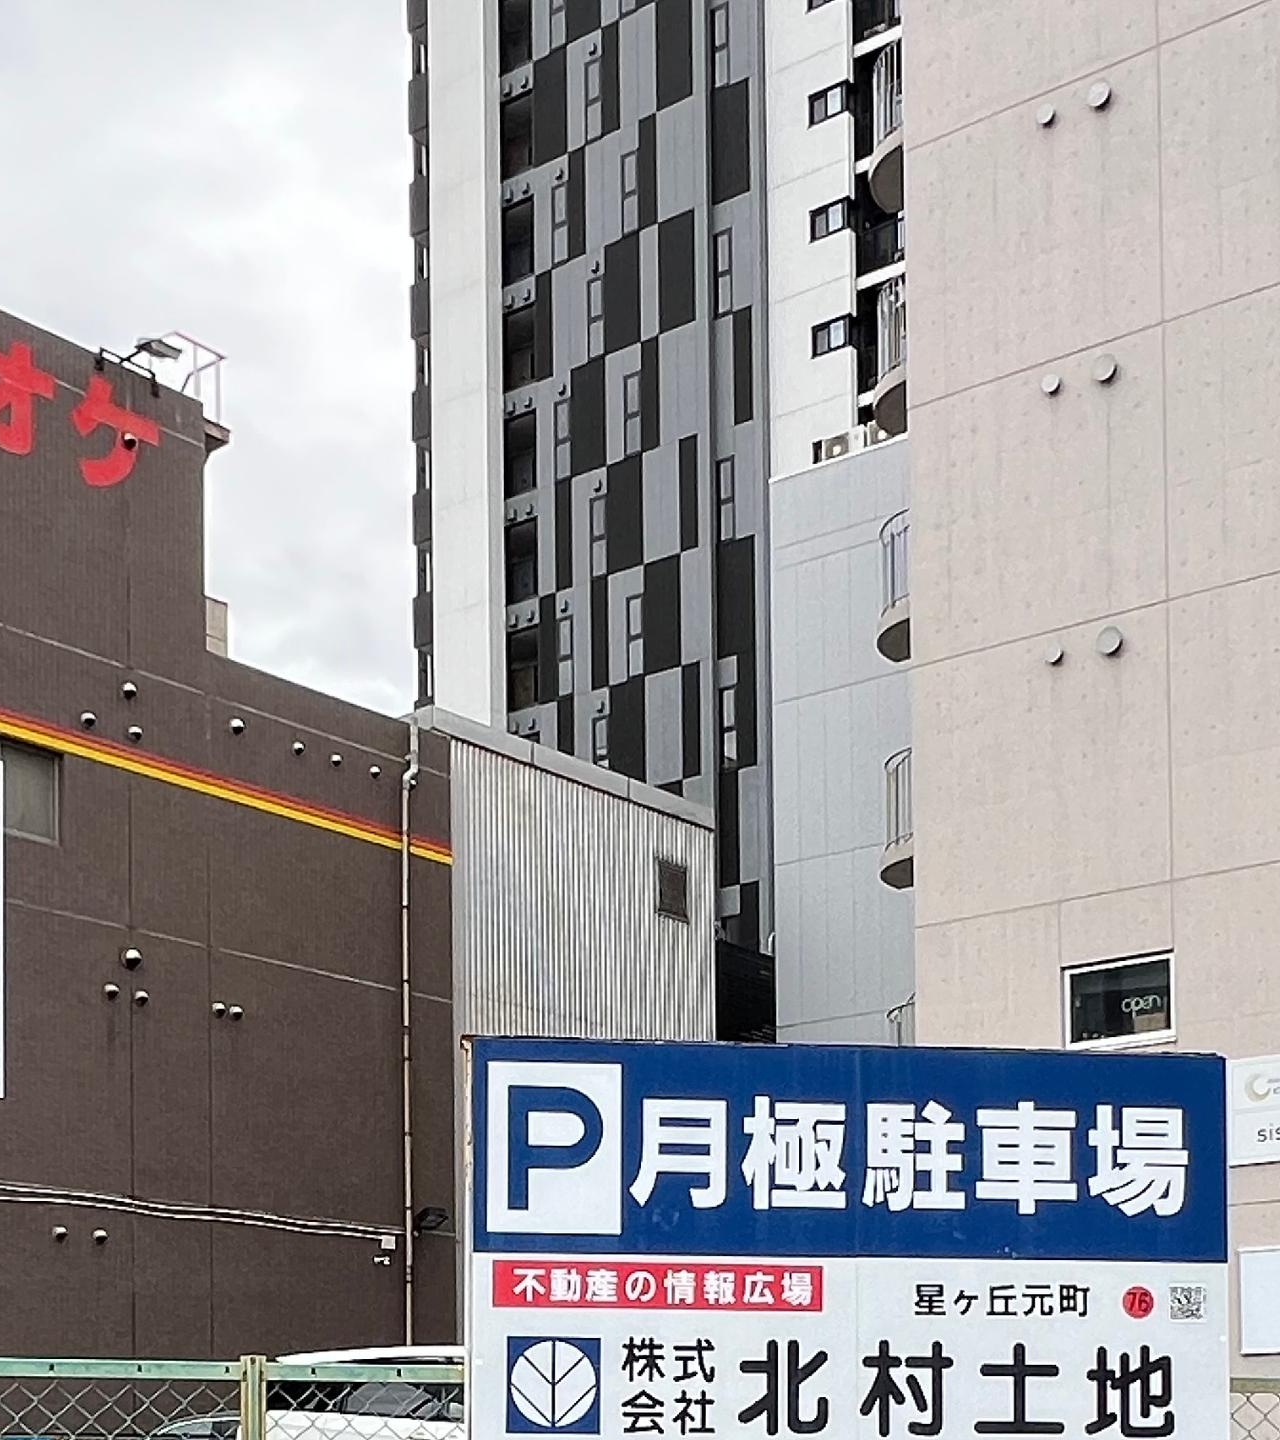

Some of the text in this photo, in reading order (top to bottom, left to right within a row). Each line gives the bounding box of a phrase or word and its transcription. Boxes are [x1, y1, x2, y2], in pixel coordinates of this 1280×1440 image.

[1121, 995, 1161, 1019] open
[507, 1084, 1190, 1217] P 月極駐車場
[512, 1266, 814, 1307] 不動産の情報広場
[1127, 1291, 1150, 1313] 76
[621, 1336, 716, 1384] 株式
[737, 1338, 1175, 1438] 北村土地
[621, 1389, 716, 1436] 会社
